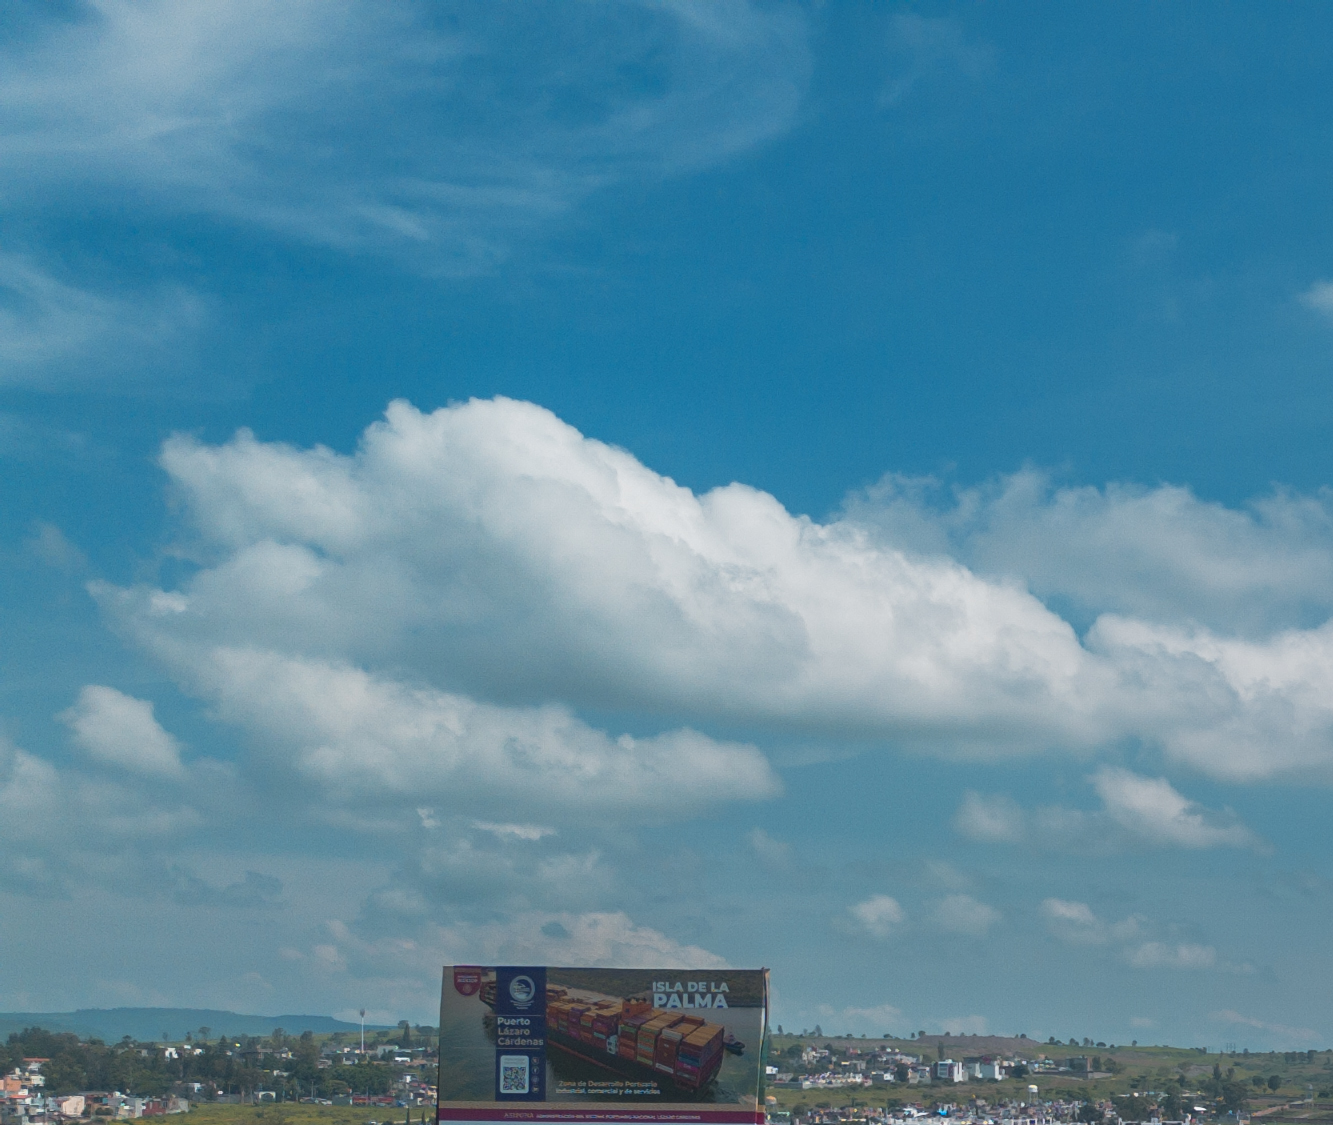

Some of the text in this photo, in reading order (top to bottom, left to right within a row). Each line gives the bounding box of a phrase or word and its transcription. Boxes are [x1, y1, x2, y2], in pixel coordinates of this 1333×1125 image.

[652, 981, 730, 993] ISLA DE LA
[653, 993, 729, 1009] PALMA
[497, 1017, 531, 1026] Puerto
[497, 1027, 530, 1036] Lázaro
[498, 1037, 544, 1046] Cárdenas
